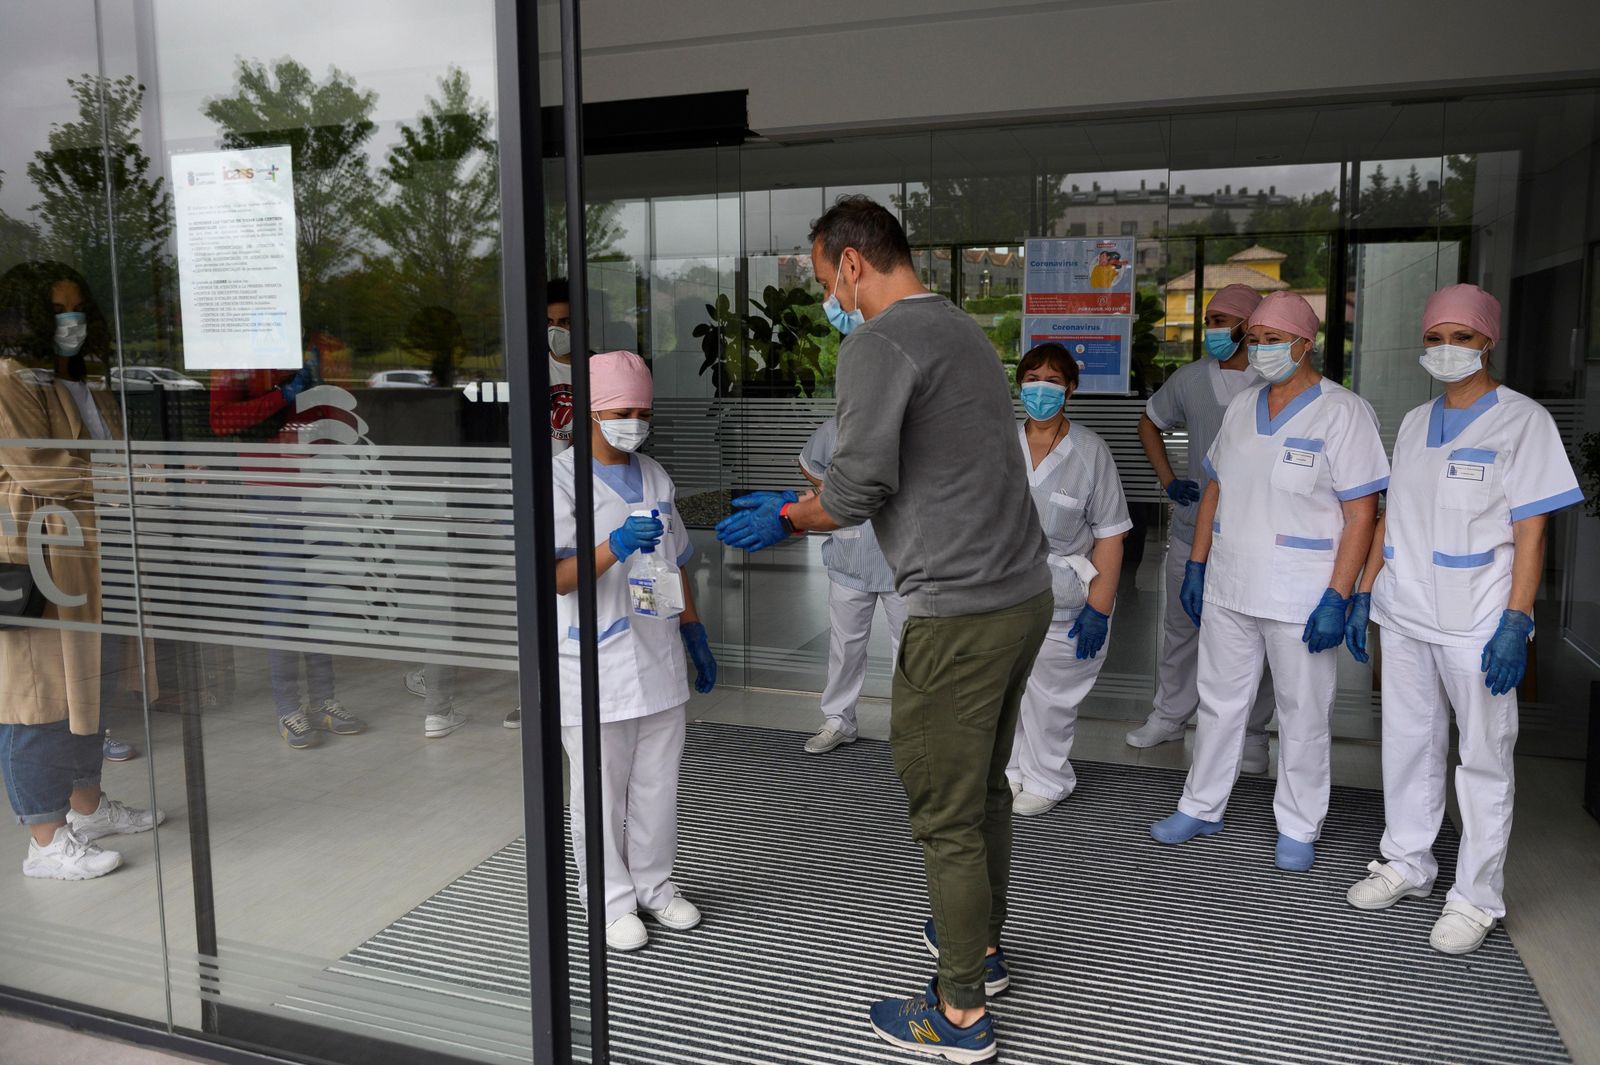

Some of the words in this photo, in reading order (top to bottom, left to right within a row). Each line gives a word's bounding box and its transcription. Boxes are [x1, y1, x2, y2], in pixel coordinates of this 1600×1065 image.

[1030, 259, 1078, 267] Coronavirus
[1052, 323, 1100, 331] Coronavirus
[908, 1019, 940, 1044] N
